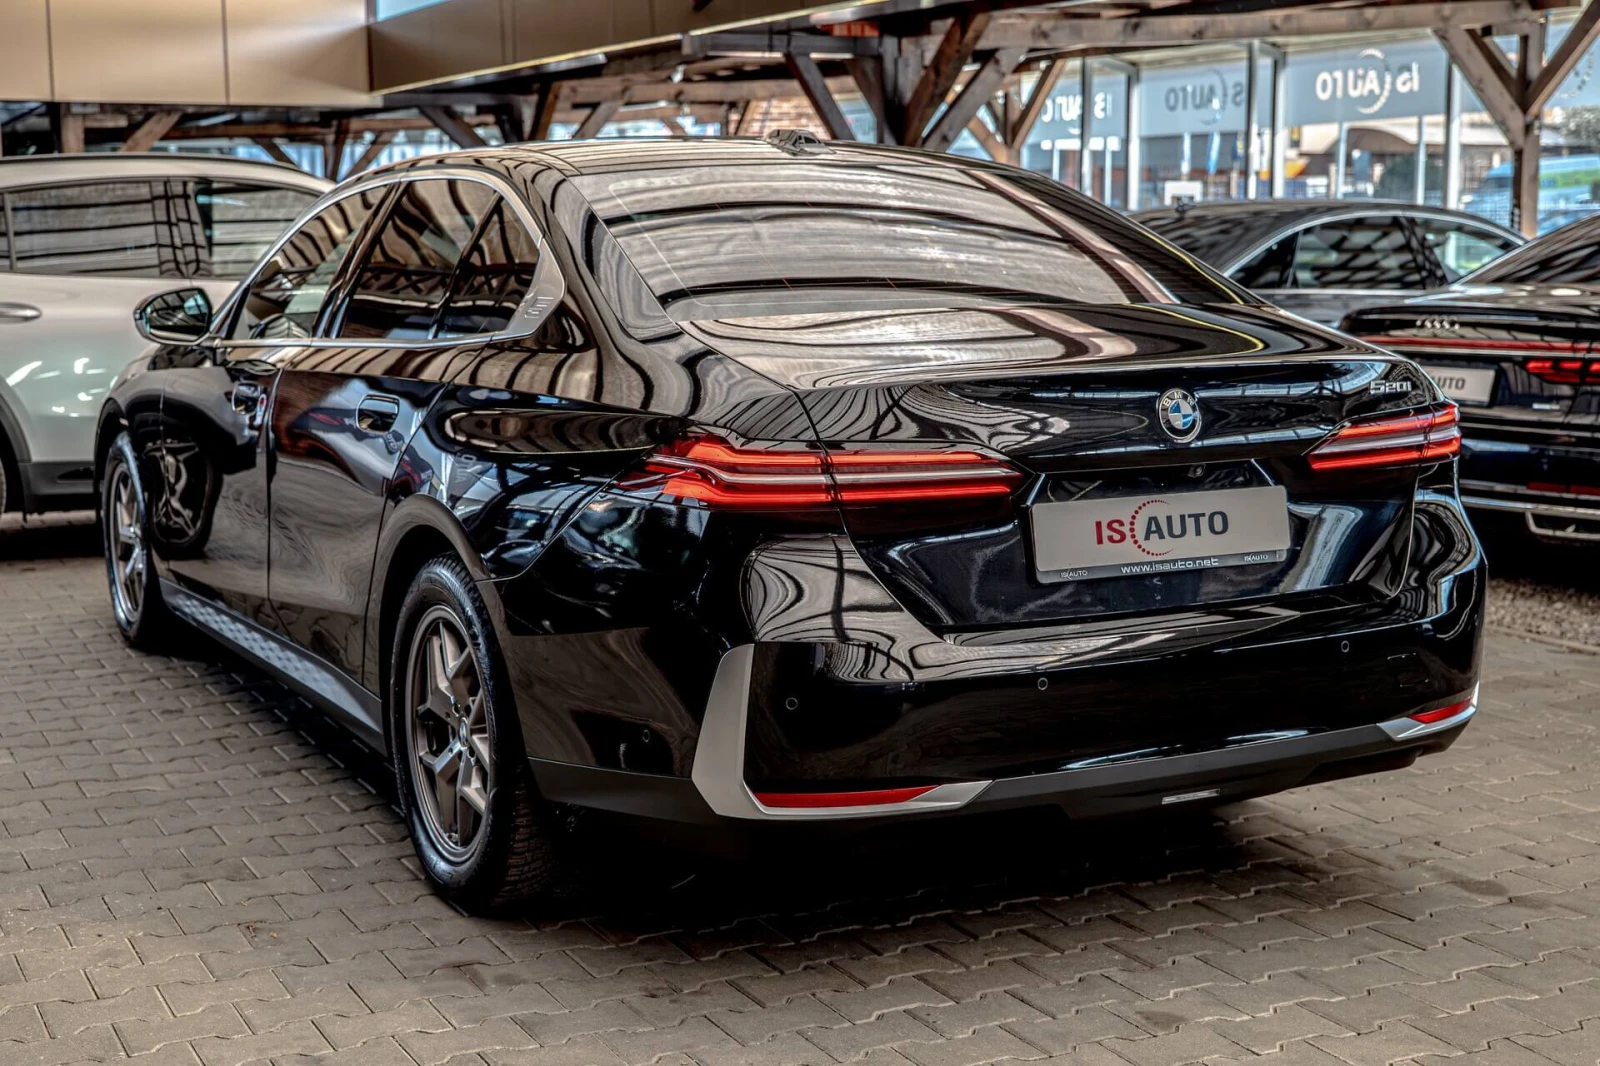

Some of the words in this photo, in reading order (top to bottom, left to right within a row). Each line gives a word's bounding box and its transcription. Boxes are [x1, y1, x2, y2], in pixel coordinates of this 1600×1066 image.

[1435, 377, 1466, 391] UTO
[1095, 519, 1127, 545] IS
[1143, 510, 1229, 541] AUTO
[1121, 557, 1219, 574] www.isauto.net
